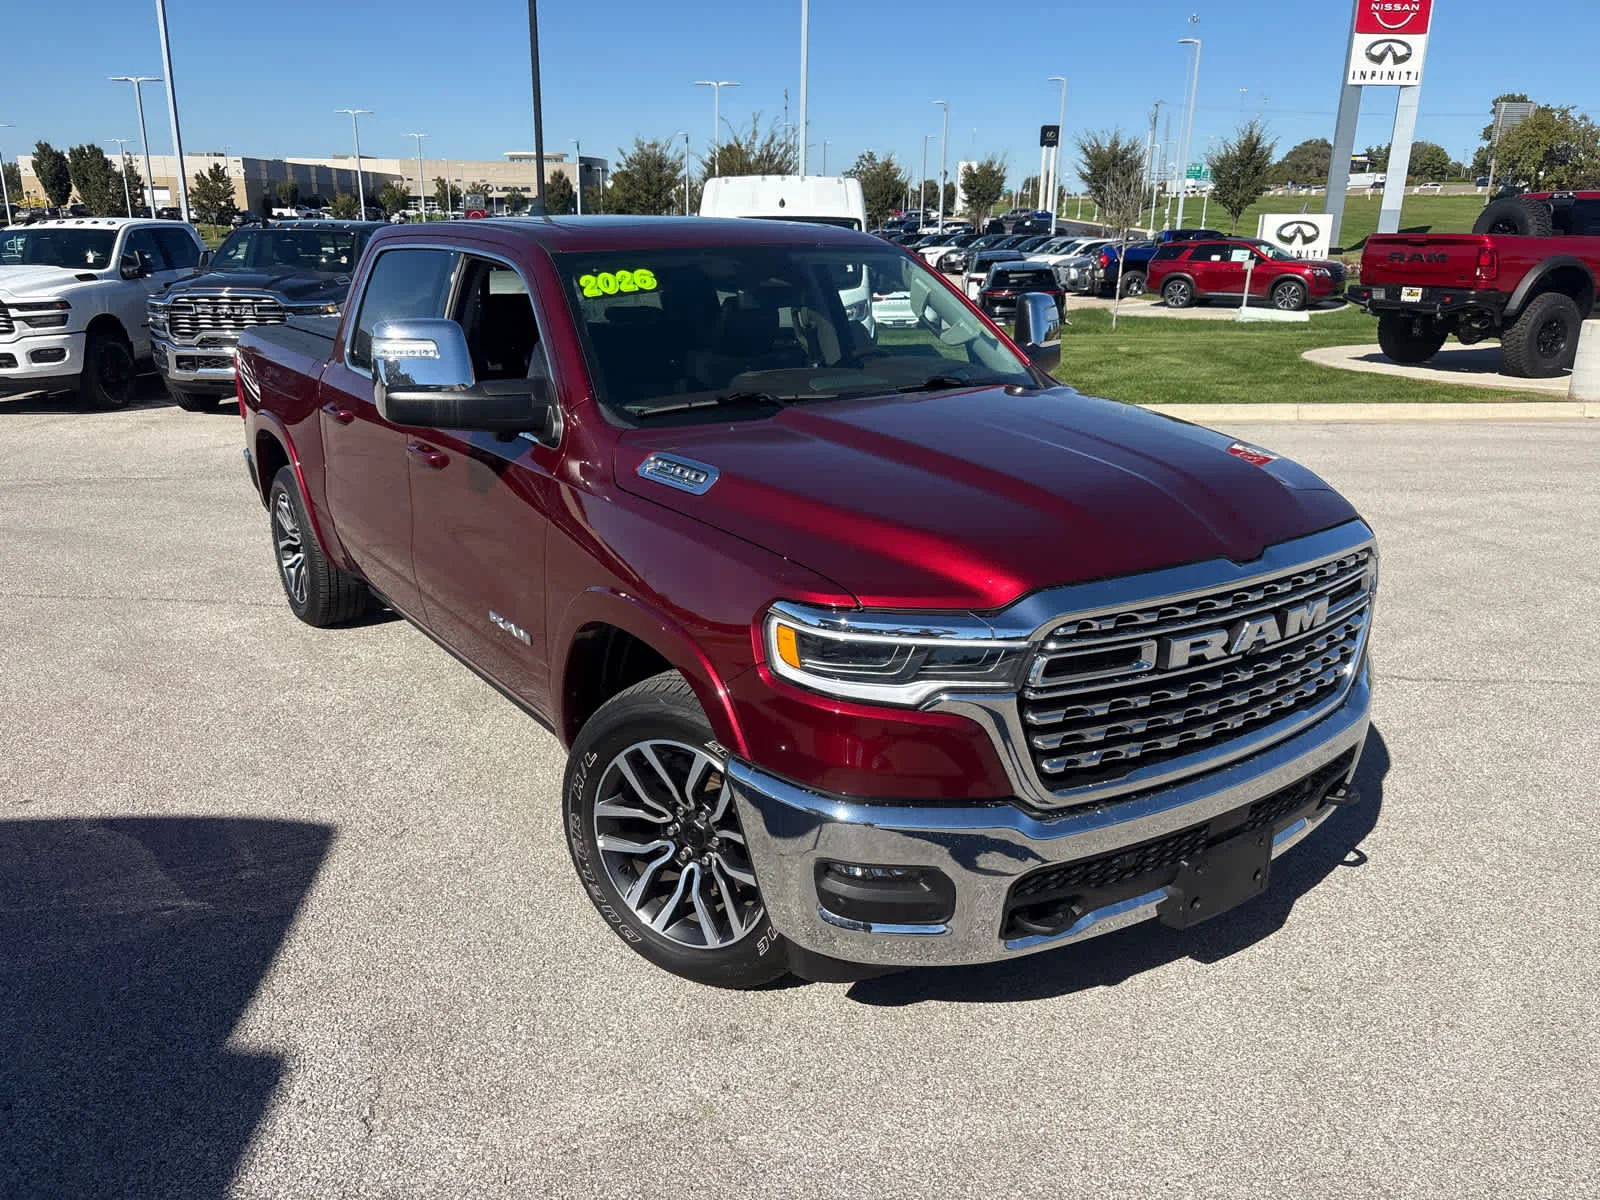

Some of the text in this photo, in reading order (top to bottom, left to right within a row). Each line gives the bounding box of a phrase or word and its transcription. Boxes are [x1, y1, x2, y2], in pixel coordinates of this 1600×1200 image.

[1371, 3, 1420, 12] NISSAN
[1352, 70, 1419, 81] INFINITI
[1289, 249, 1324, 258] INITI
[1387, 251, 1449, 263] RAM
[579, 268, 658, 298] 2026
[488, 609, 532, 647] RAM
[1160, 593, 1330, 670] RAM
